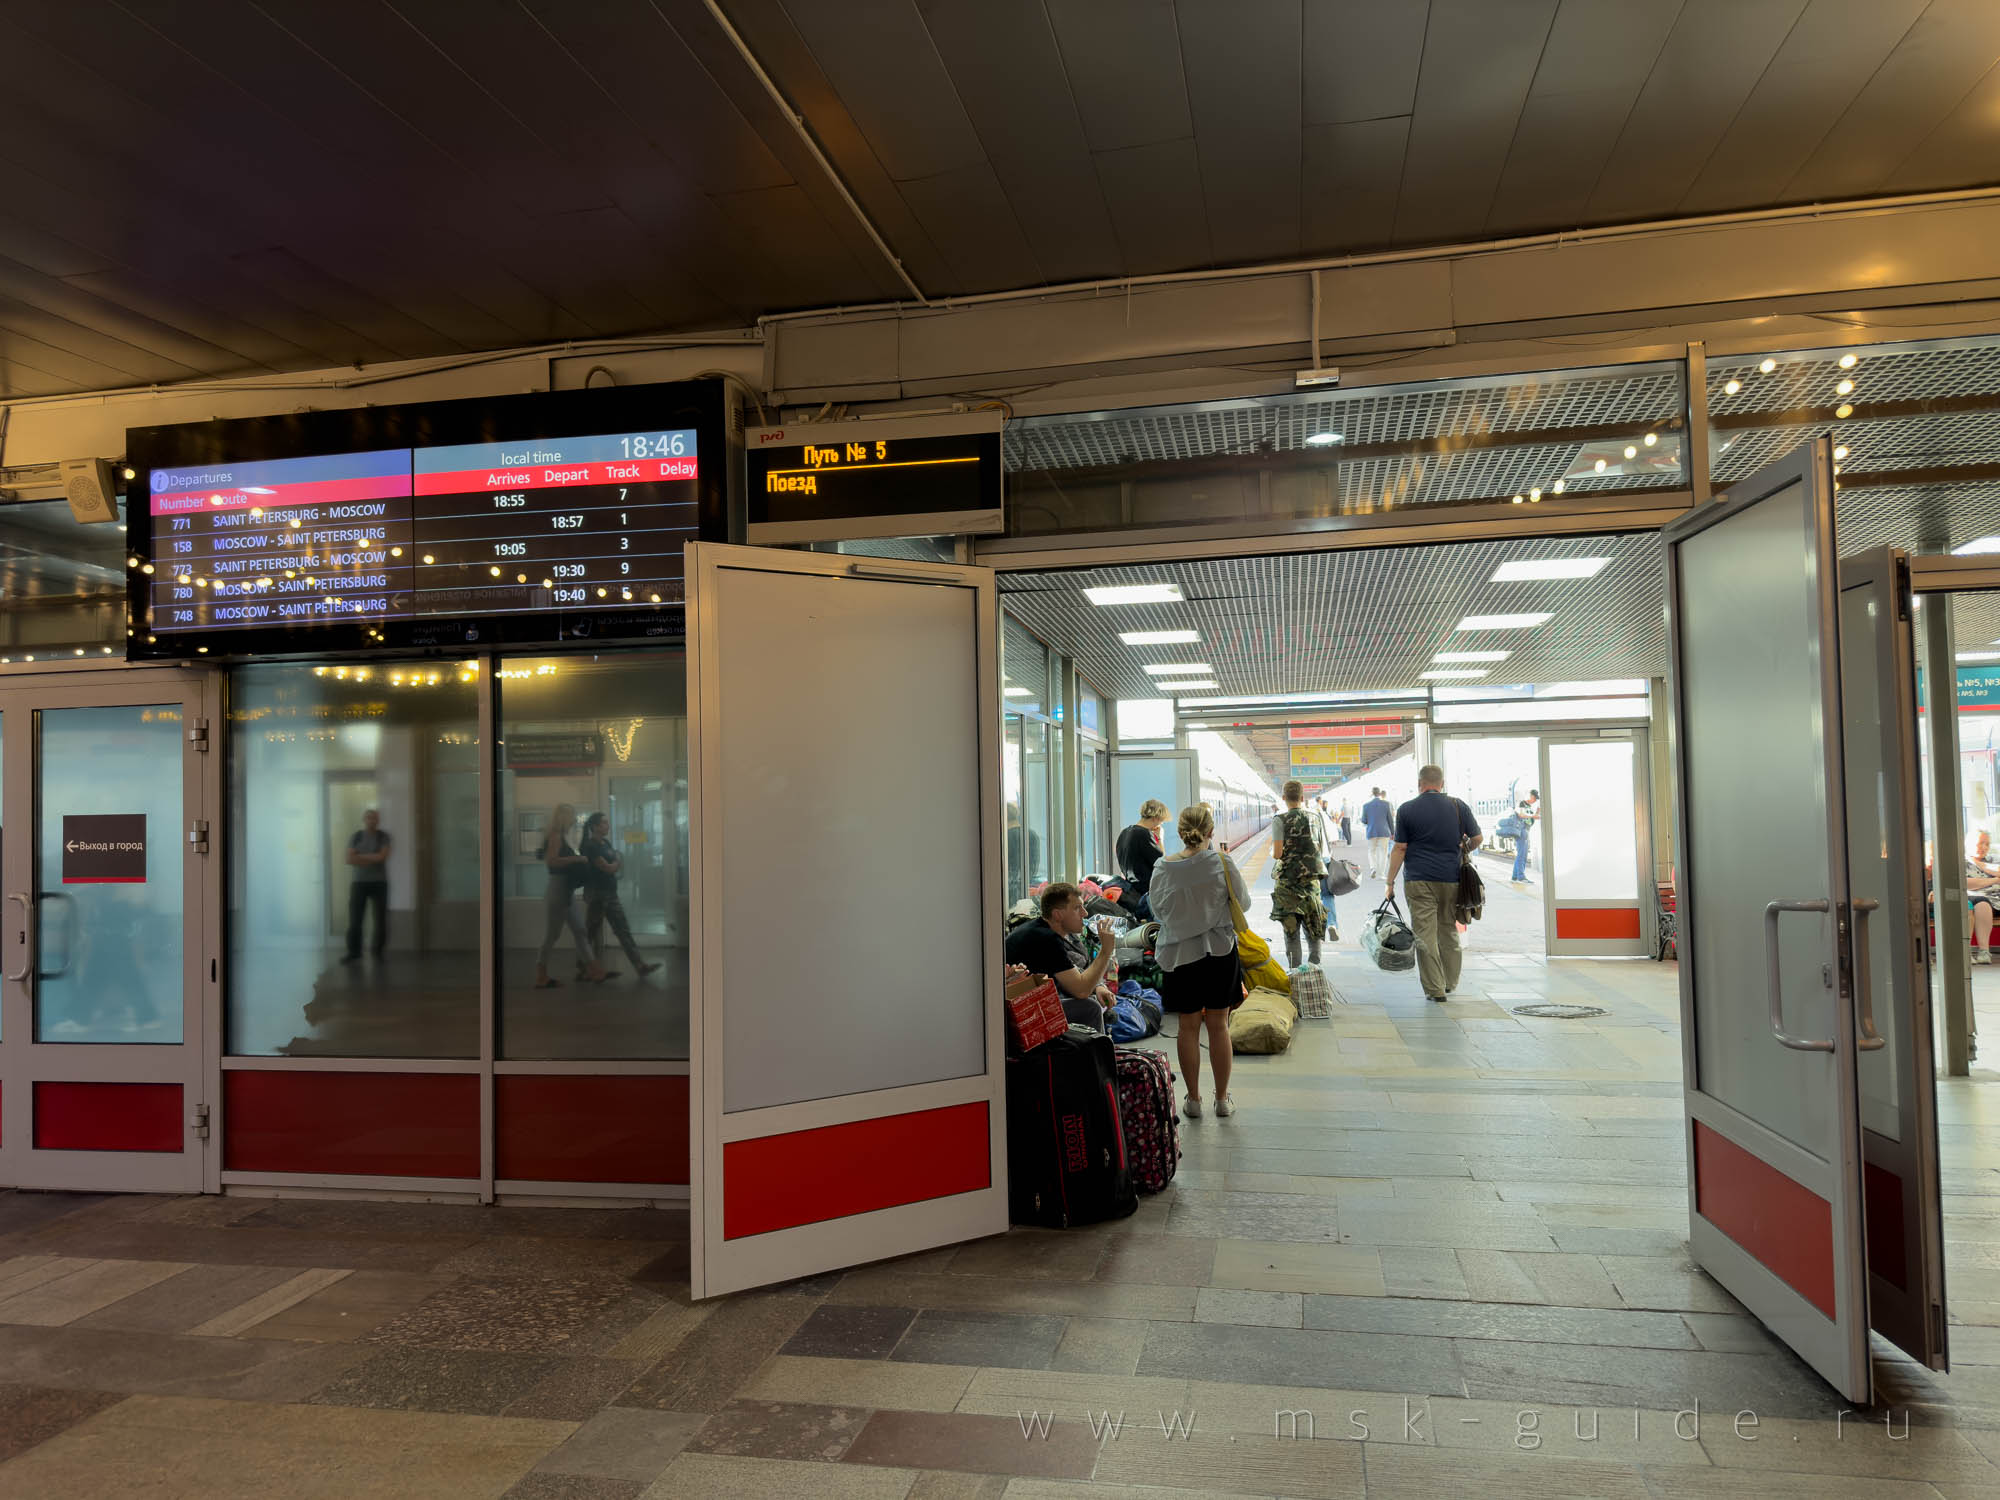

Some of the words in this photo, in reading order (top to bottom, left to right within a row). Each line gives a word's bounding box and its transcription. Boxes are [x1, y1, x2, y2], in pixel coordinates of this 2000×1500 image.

[620, 434, 685, 459] 18:46
[803, 445, 839, 468] Путь
[846, 442, 867, 462] №
[876, 441, 886, 459] 5
[501, 452, 531, 466] local
[533, 450, 562, 464] time
[170, 472, 233, 488] Departures
[487, 472, 531, 486] Arrives
[544, 468, 589, 484] Depart
[605, 464, 640, 479] Track
[660, 462, 697, 478] Delay
[767, 474, 817, 495] Поезд
[159, 495, 205, 511] Number
[213, 494, 248, 506] oute
[493, 495, 526, 508] 18:55
[619, 488, 628, 501] 7
[172, 518, 192, 531] 771
[213, 513, 246, 528] SAINT
[249, 508, 319, 525] PETERSBURG
[329, 503, 386, 519] MOSCOW
[551, 515, 584, 529] 18:57
[620, 513, 627, 525] 1
[173, 541, 193, 553] 158
[214, 535, 268, 551] MOSCOW
[277, 532, 311, 547] SAINT
[313, 527, 386, 544] PETERSBURG
[620, 538, 629, 550] 3
[494, 543, 527, 556] 19:05
[173, 564, 193, 577] 773
[213, 560, 247, 574] SAINT
[249, 555, 320, 571] PETERSBURG
[330, 551, 387, 566] MOSCOW
[552, 564, 586, 578] 19:30
[621, 562, 630, 574] 9
[173, 587, 193, 600] 780
[215, 580, 268, 597] MOSCOW
[278, 579, 312, 593] SAINT
[314, 574, 387, 591] PETERSBURG
[553, 588, 586, 602] 19:40
[173, 610, 194, 623] 748
[215, 605, 270, 620] MOSCOW
[279, 602, 313, 617] SAINT
[315, 598, 387, 615] PETERSBURG
[79, 841, 108, 852] Выход
[116, 842, 143, 852] город
